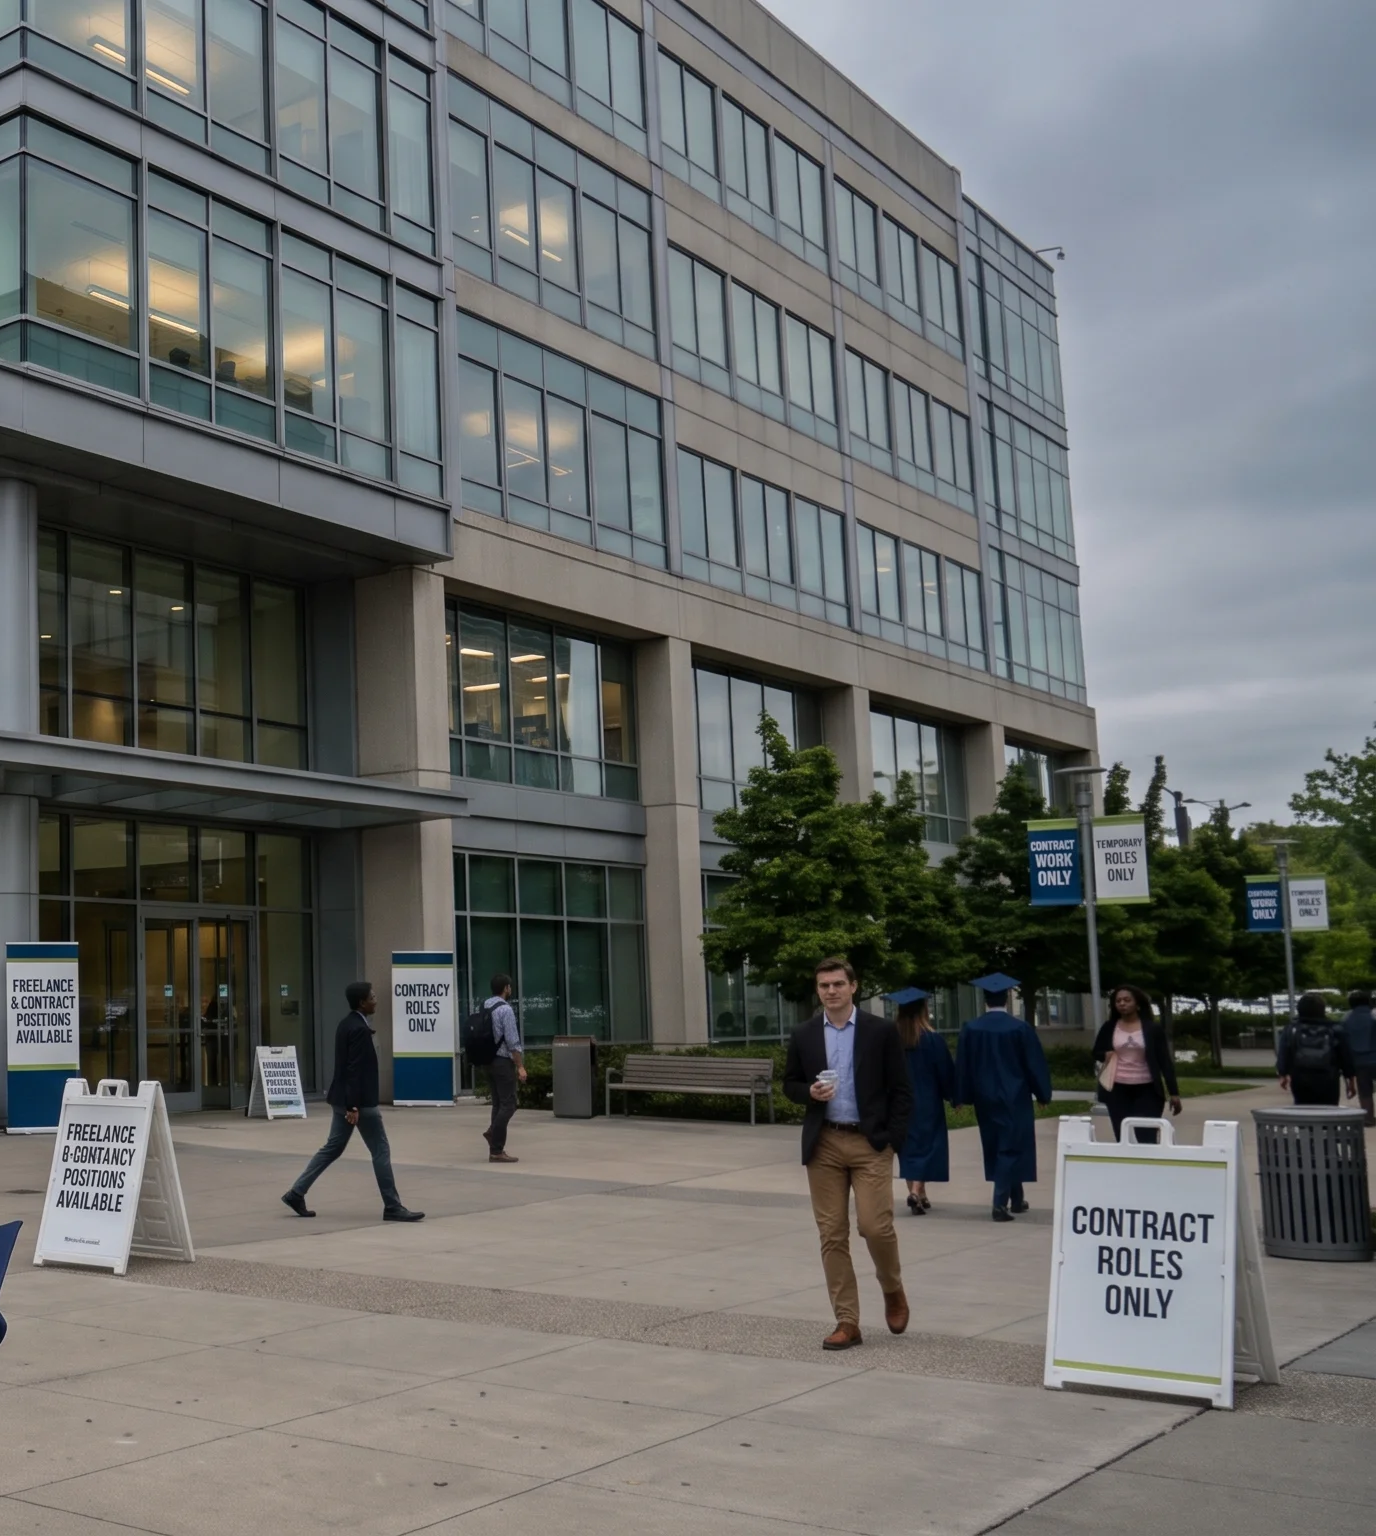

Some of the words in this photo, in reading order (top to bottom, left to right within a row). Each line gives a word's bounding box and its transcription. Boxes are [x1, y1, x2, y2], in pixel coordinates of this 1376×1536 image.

[1030, 839, 1075, 852] CONTRACT
[1096, 838, 1143, 849] TEMPORARY
[1035, 852, 1073, 868] WORK
[1104, 851, 1138, 865] ROLES
[1037, 870, 1072, 886] ONLY
[1107, 868, 1135, 882] ONLY
[12, 979, 74, 993] FREELANCE
[394, 983, 450, 997] CONTRACY
[10, 996, 19, 1010] &
[21, 995, 76, 1010] CONTRACT
[405, 1000, 440, 1015] ROLES
[408, 1017, 437, 1032] ONLY
[15, 1029, 73, 1044] AVAILABLE
[66, 1123, 137, 1144] FREELANCE
[62, 1168, 126, 1189] POSITIONS
[55, 1190, 124, 1213] AVAILABLE
[1071, 1205, 1214, 1244] CONTRACT
[1097, 1245, 1183, 1281] ROLES
[1105, 1284, 1174, 1319] ONLY
